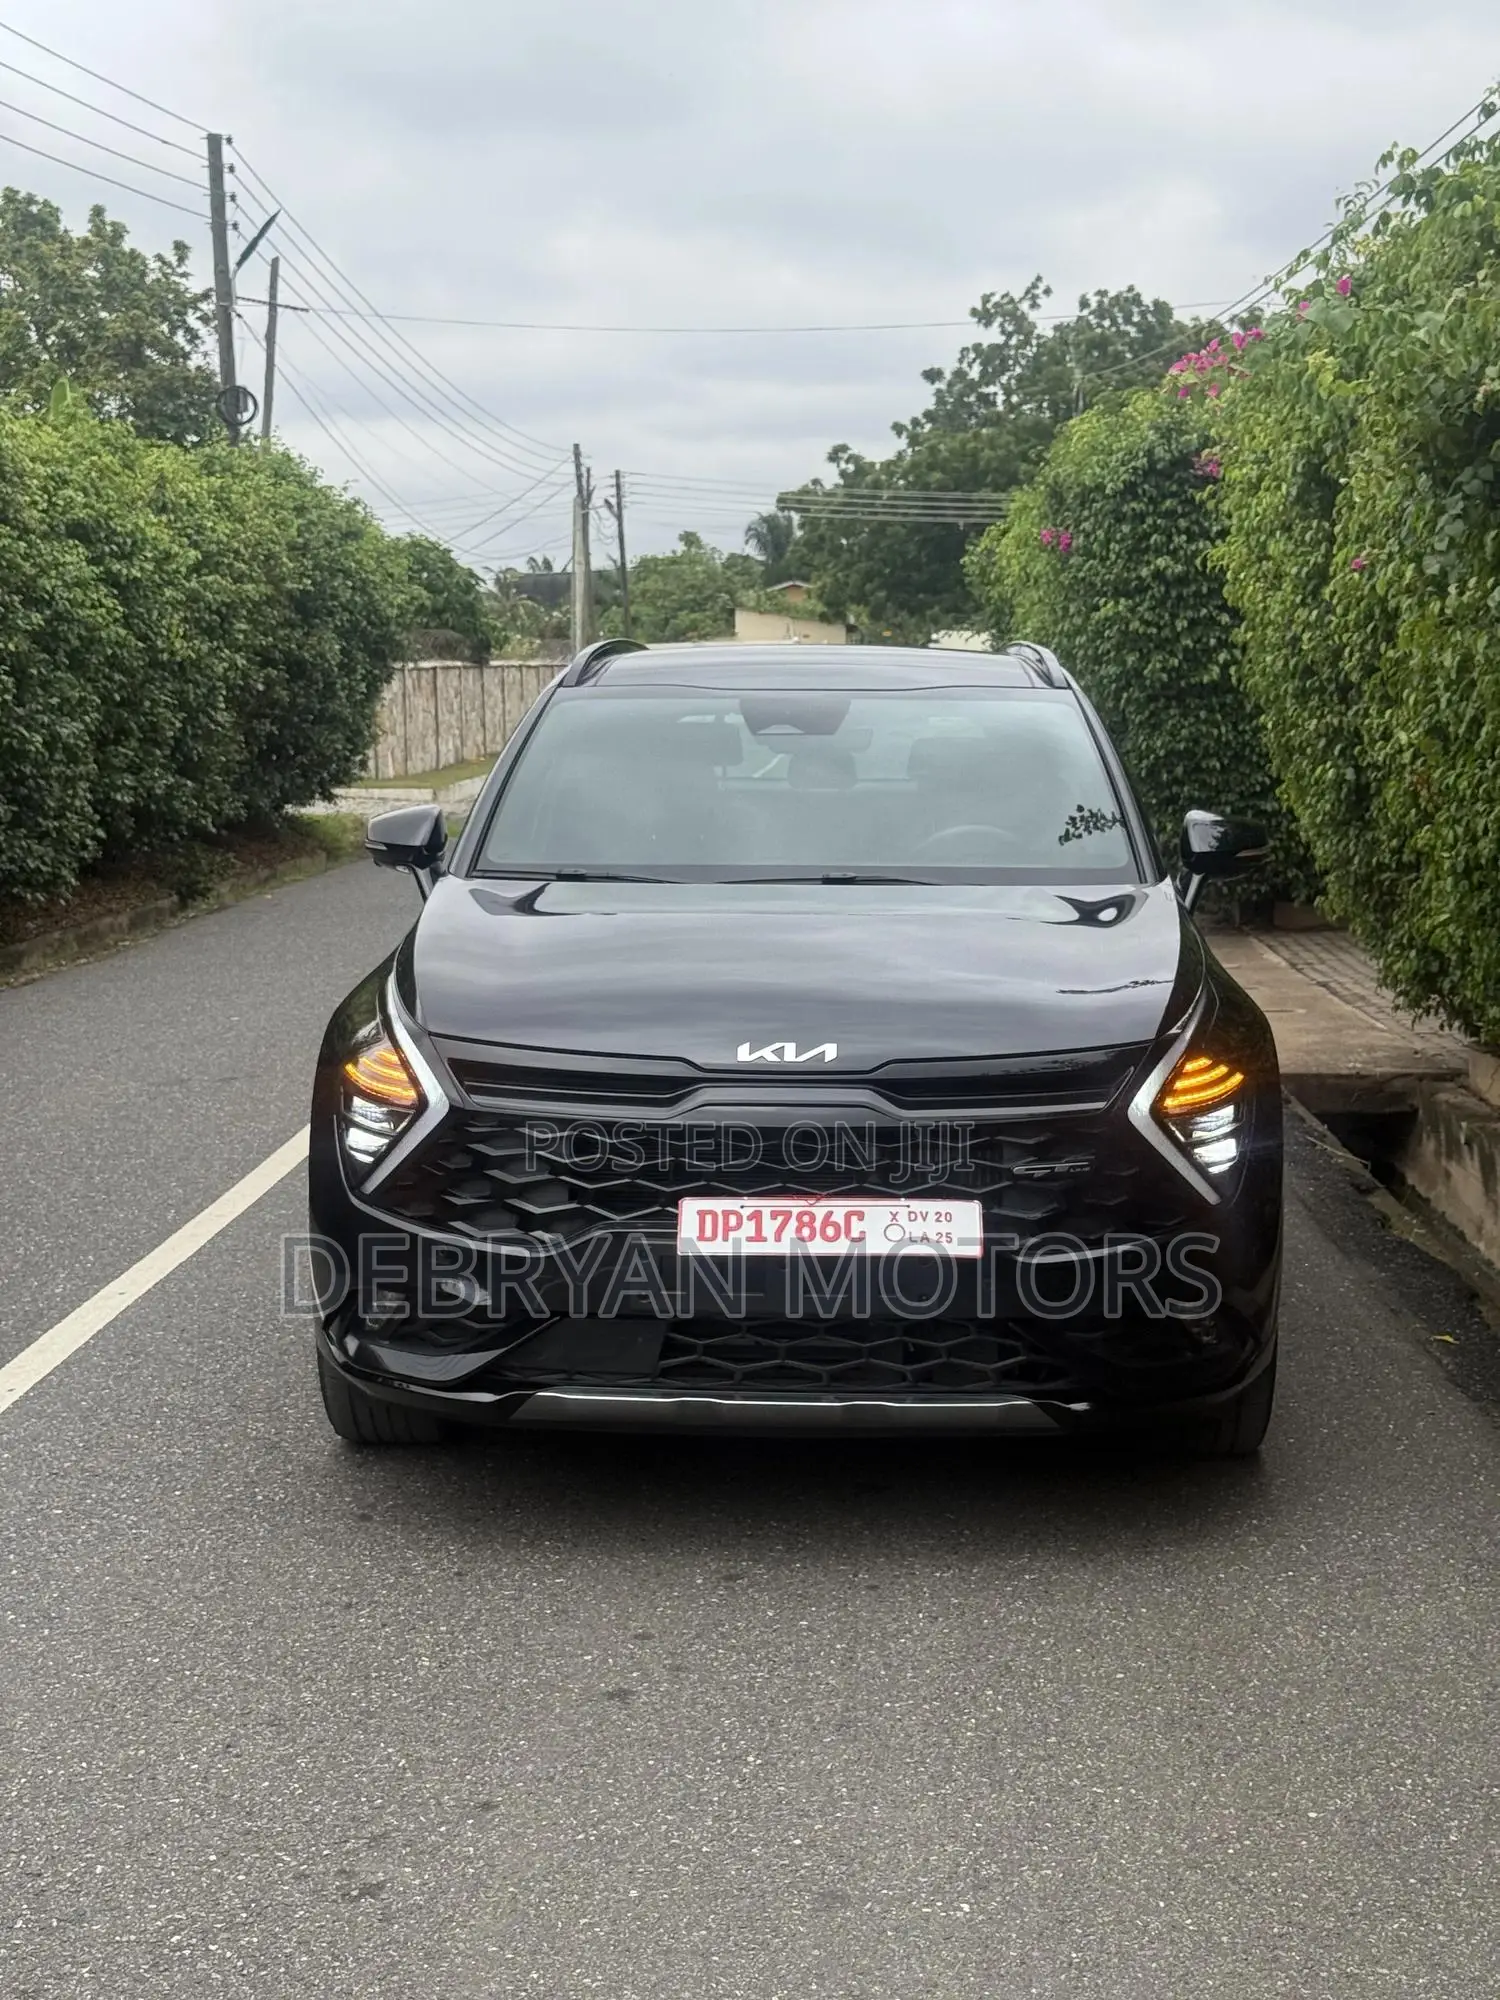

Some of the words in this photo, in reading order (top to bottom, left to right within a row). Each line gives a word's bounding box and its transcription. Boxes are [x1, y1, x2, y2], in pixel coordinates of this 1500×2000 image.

[736, 1041, 838, 1063] KIA
[908, 1211, 929, 1222] DV
[934, 1211, 953, 1223] 20
[696, 1210, 865, 1243] DP1786C
[909, 1231, 930, 1243] LA
[935, 1232, 953, 1244] 25
